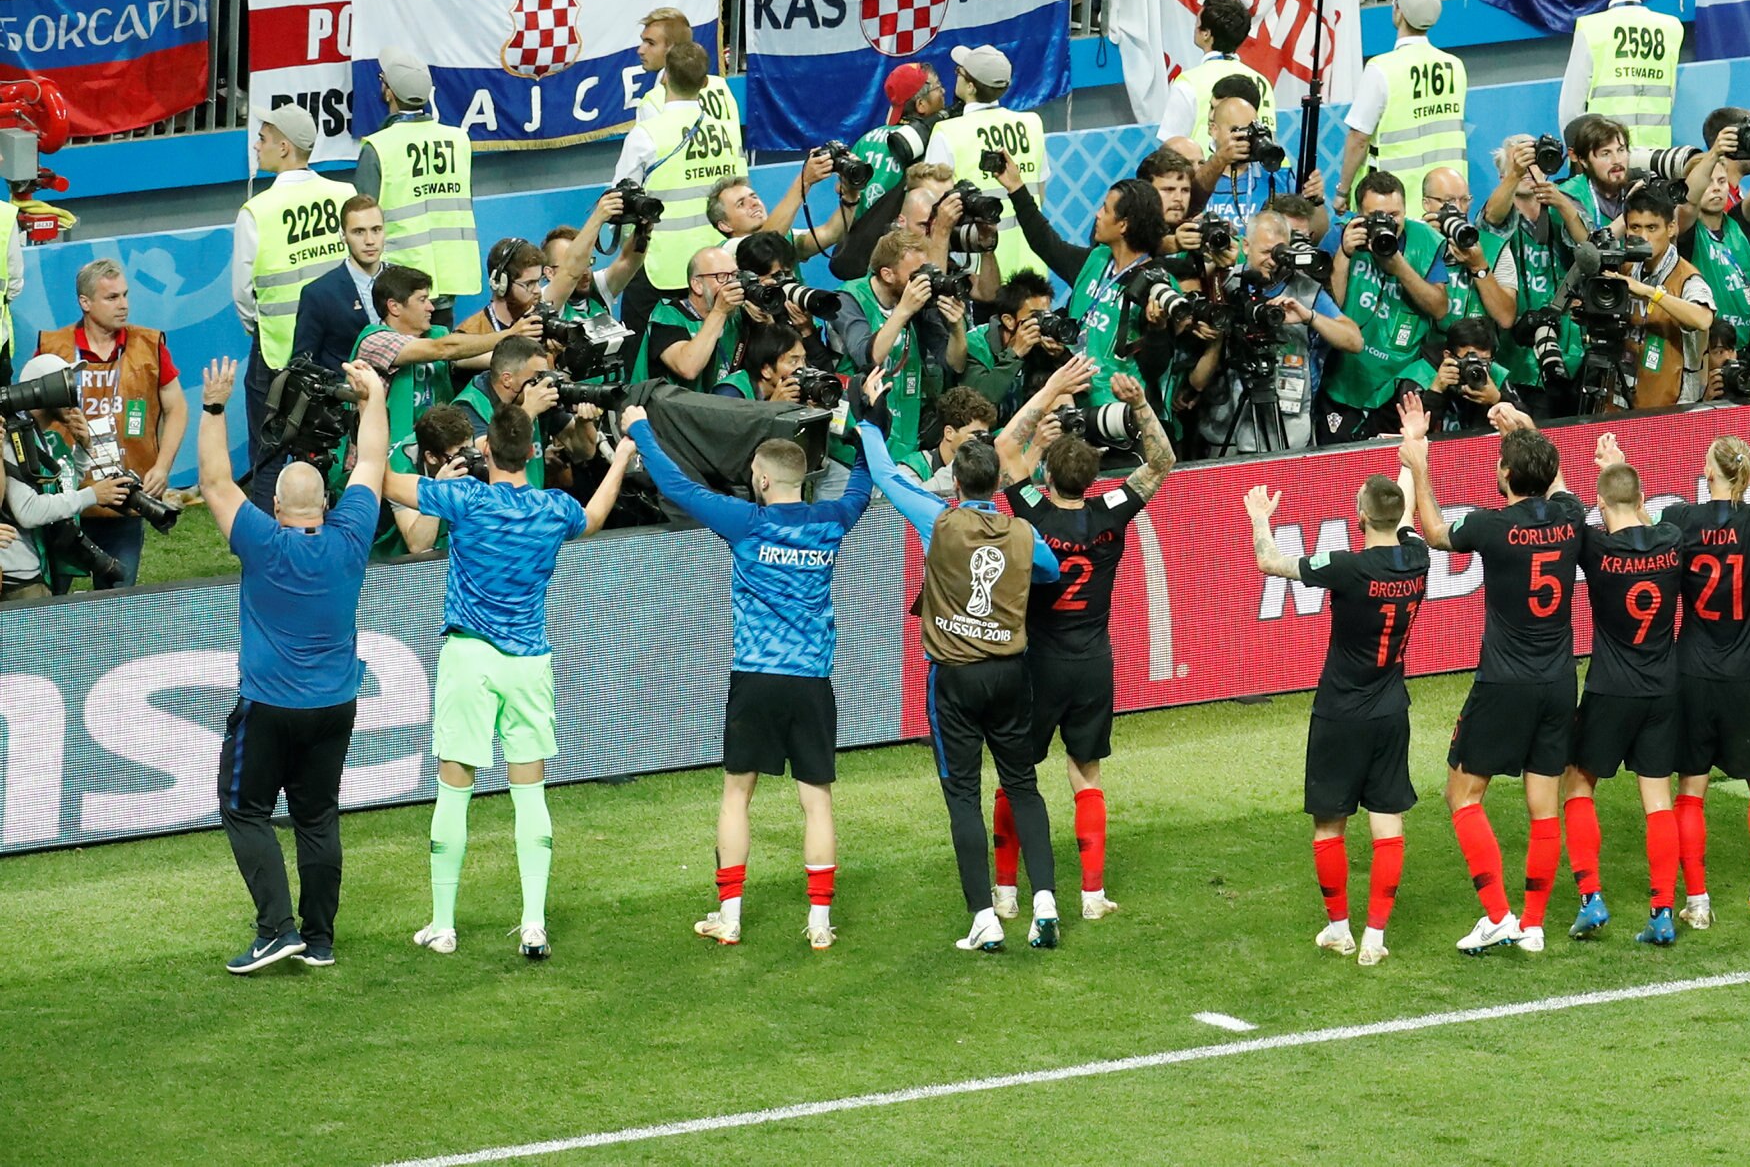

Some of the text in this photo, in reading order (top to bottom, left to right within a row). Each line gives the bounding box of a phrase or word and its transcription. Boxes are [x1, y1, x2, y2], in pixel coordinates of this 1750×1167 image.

[1614, 26, 1666, 61] 2598
[1410, 61, 1456, 101] 2167
[1614, 65, 1665, 81] STEWARD
[1412, 101, 1461, 120] STEWARD
[406, 140, 457, 178] 2157
[413, 181, 462, 198] STEWARD
[282, 198, 342, 244] 2228
[288, 241, 348, 265] STEWARD
[82, 369, 117, 388] RTV
[1508, 523, 1576, 546] ĆORLUKA
[1701, 528, 1738, 546] VIDA
[758, 544, 836, 567] HRVATSKA
[1601, 550, 1679, 574] KRAMARIĆ
[1051, 555, 1094, 611] 2
[1528, 550, 1562, 618] 5
[1689, 553, 1745, 622] 21
[965, 616, 987, 627] WORLD
[986, 620, 1000, 630] CUP
[1625, 580, 1663, 645] 9
[935, 615, 1012, 642] RUSSIA 2018
